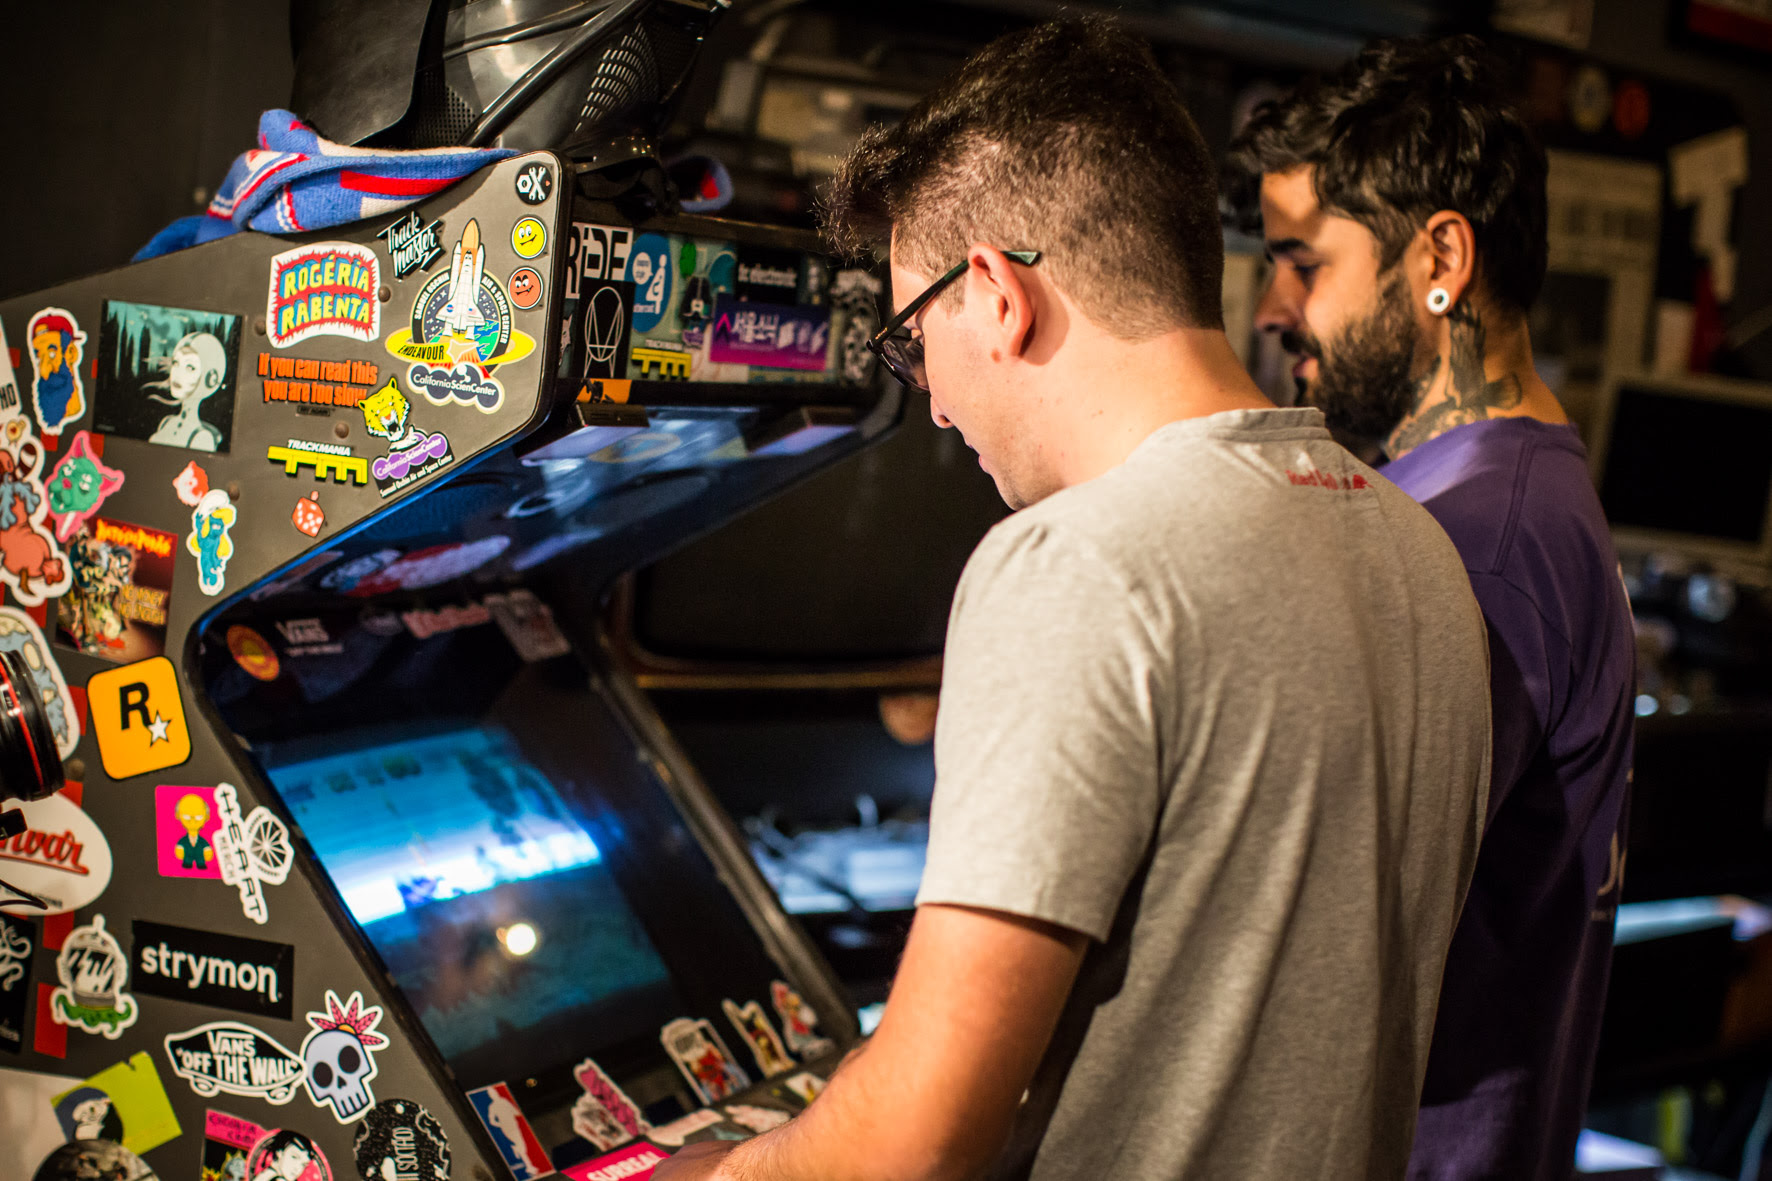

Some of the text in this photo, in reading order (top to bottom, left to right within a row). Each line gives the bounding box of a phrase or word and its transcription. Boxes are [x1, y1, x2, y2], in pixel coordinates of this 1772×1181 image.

[280, 253, 369, 299] ROGÉRIA
[277, 292, 369, 336] RABENTA
[258, 352, 378, 385] If you can read this
[398, 344, 444, 360] ENDEAVOUR
[263, 380, 367, 407] you are too slow
[287, 438, 351, 456] TRACKMANIA
[119, 681, 151, 731] R
[220, 790, 262, 916] HEART
[220, 836, 235, 879] MERCH
[141, 942, 279, 1003] strymon
[206, 1031, 257, 1058] VANS
[213, 1054, 249, 1085] THE
